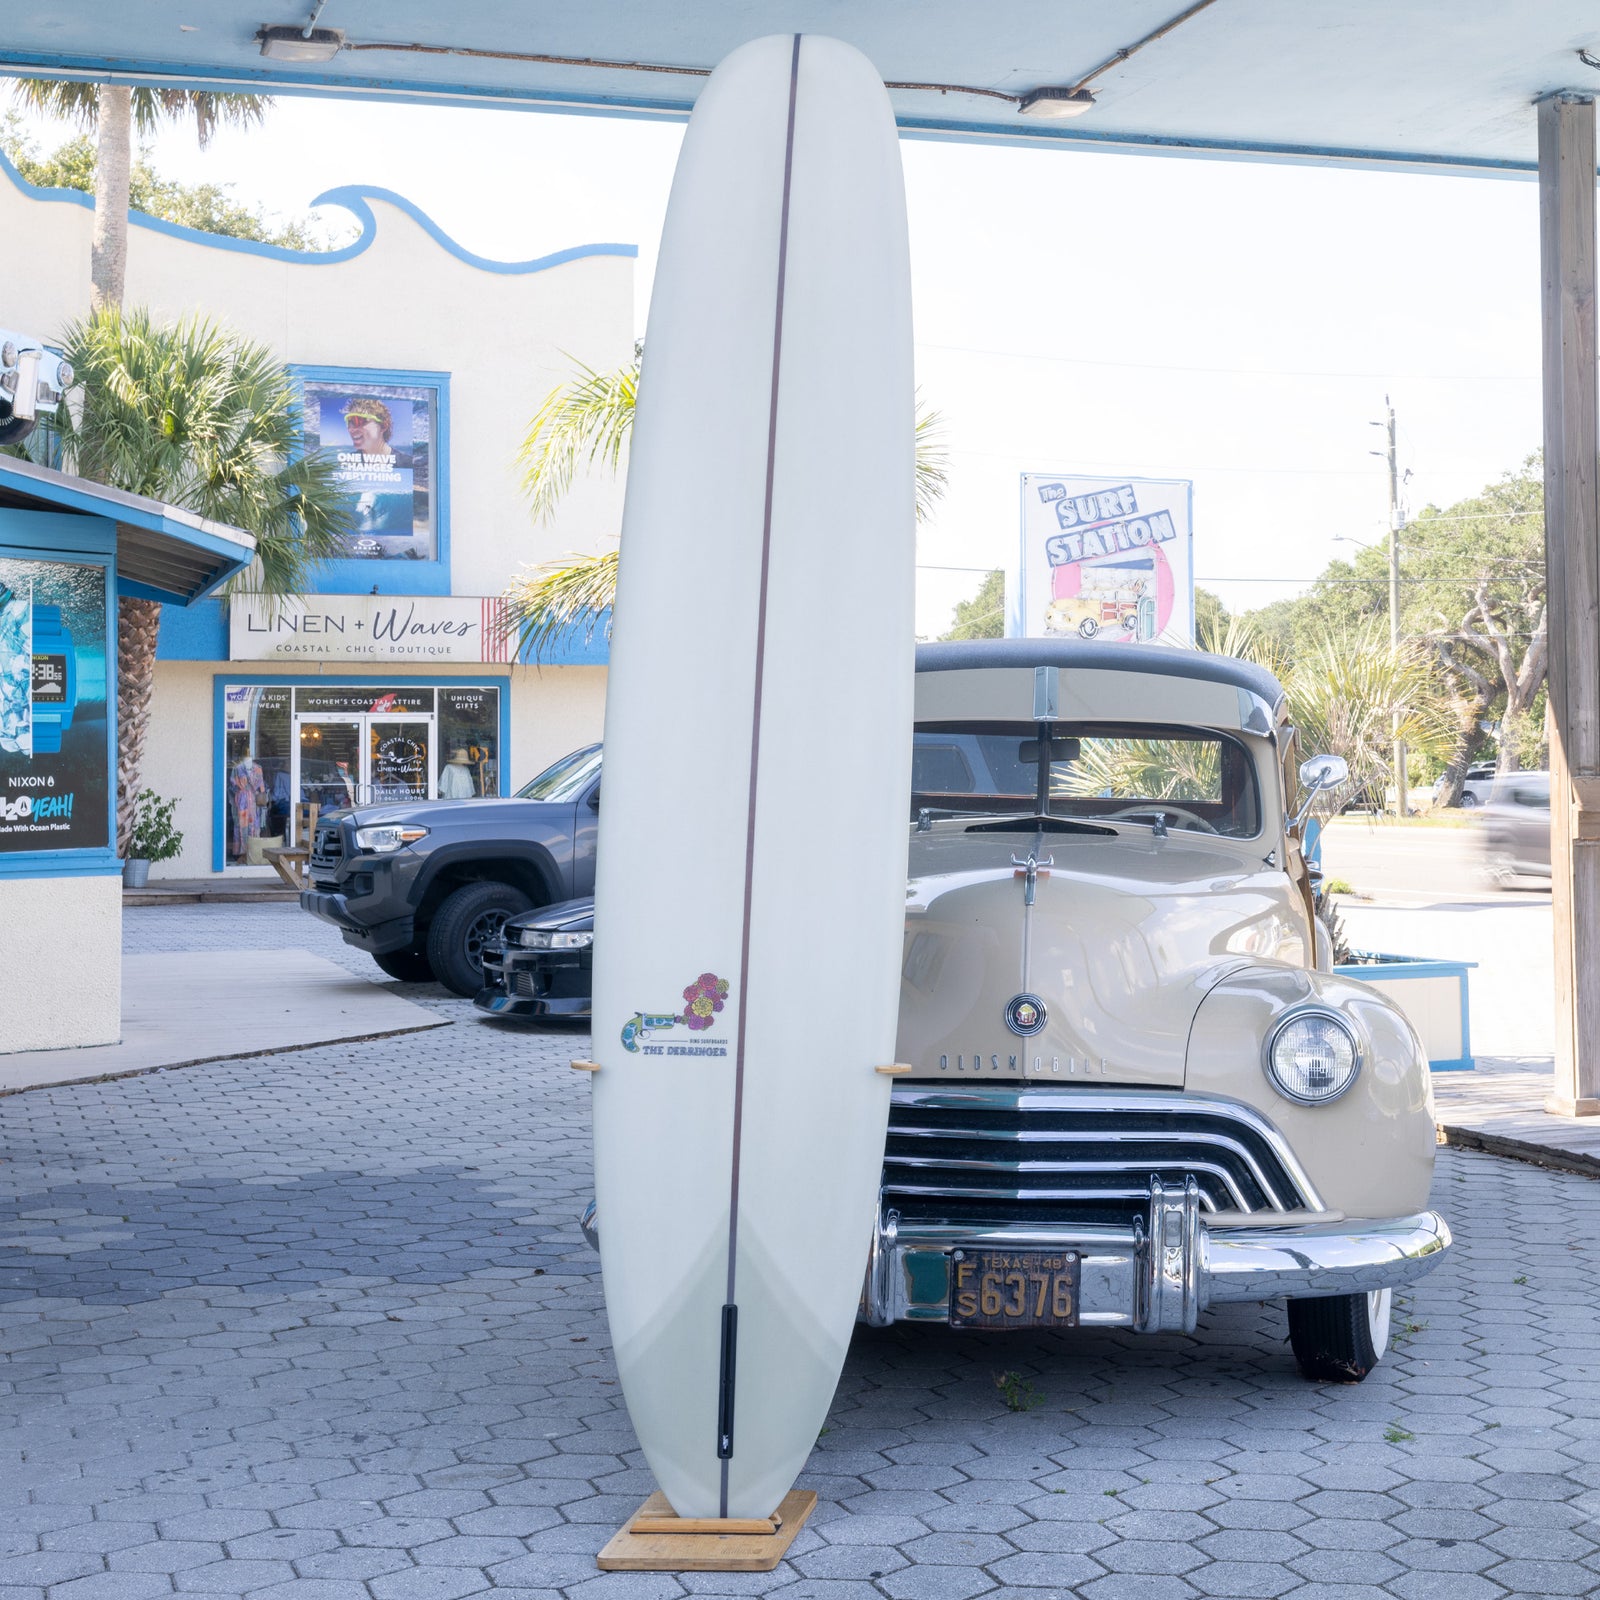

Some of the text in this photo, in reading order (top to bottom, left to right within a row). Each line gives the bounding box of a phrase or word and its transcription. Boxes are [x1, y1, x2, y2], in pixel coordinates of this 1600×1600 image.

[337, 453, 396, 463] ONE WAVE
[340, 463, 393, 472] CHANGES
[332, 472, 401, 481] EVERYTHING
[1040, 486, 1065, 502] The
[1057, 487, 1136, 527] SURF
[1046, 512, 1173, 565] STATION
[248, 613, 345, 633] LINEN
[373, 602, 477, 642] Waves
[276, 645, 452, 655] COASTAL CHIC BOUTIQUE
[380, 737, 405, 752] COASTAL
[8, 776, 46, 787] NIXON
[31, 792, 74, 823] YEAH!
[0, 822, 71, 833] ade With Ocean Plastic
[642, 1045, 727, 1057] THE DERRINGER
[940, 1054, 1108, 1075] OLDSMOBILE
[982, 1257, 1062, 1270] TEXAS 48
[957, 1263, 976, 1288] F
[981, 1273, 1073, 1318] 6376
[956, 1292, 977, 1317] S
